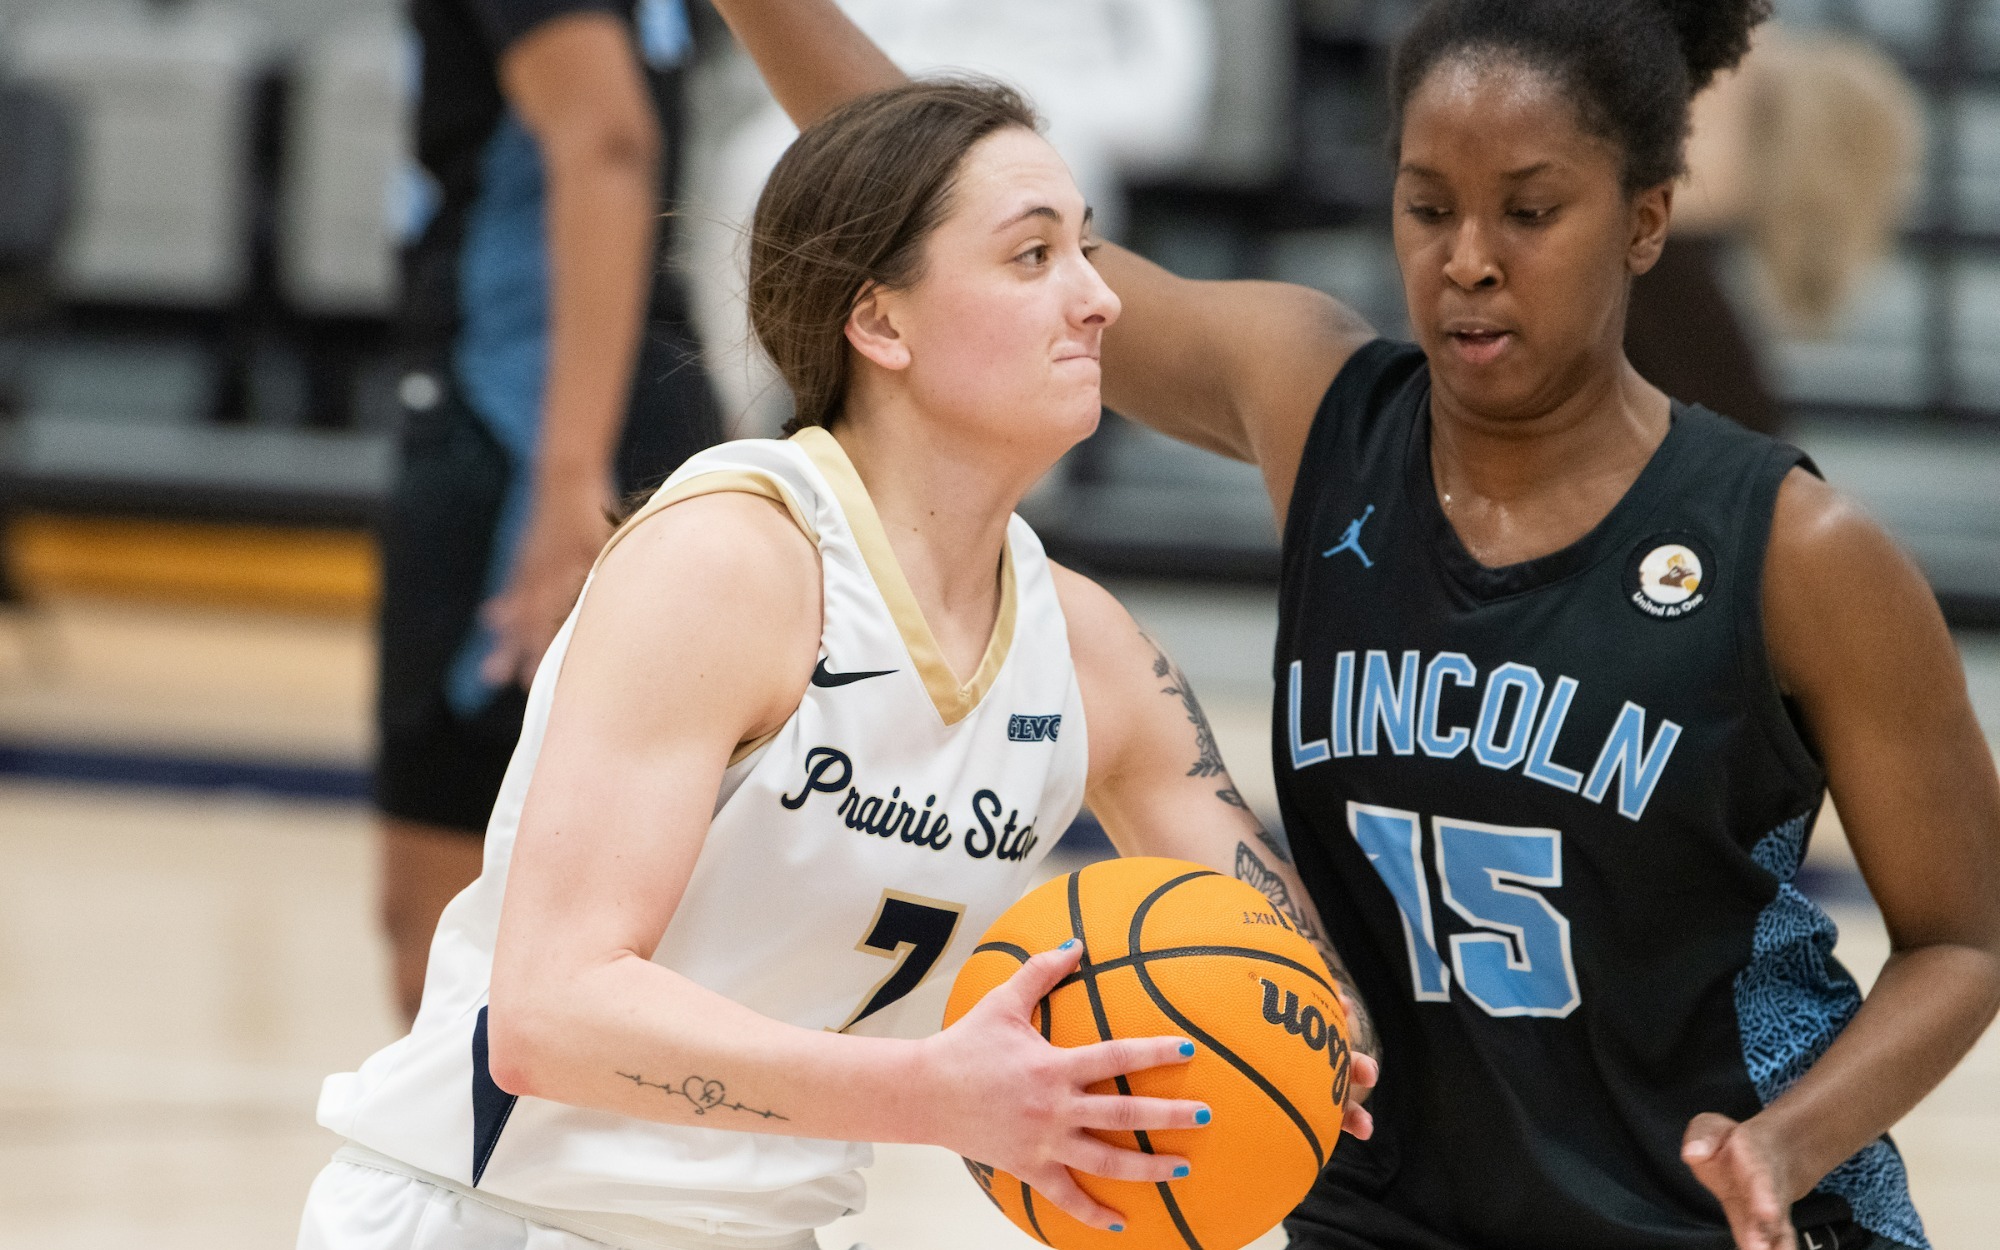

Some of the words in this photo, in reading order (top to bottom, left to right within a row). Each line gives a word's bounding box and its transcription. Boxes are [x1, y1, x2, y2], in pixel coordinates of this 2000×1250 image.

[1632, 591, 1666, 616] United
[1666, 606, 1681, 616] As
[1681, 594, 1704, 612] One
[780, 746, 952, 851] Prairie
[963, 788, 1039, 862] Sta
[1288, 650, 1683, 822] LINCOLN
[823, 887, 968, 1034] 7
[1243, 911, 1278, 926] NXT
[1346, 800, 1582, 1019] 15
[1259, 976, 1350, 1113] lson
